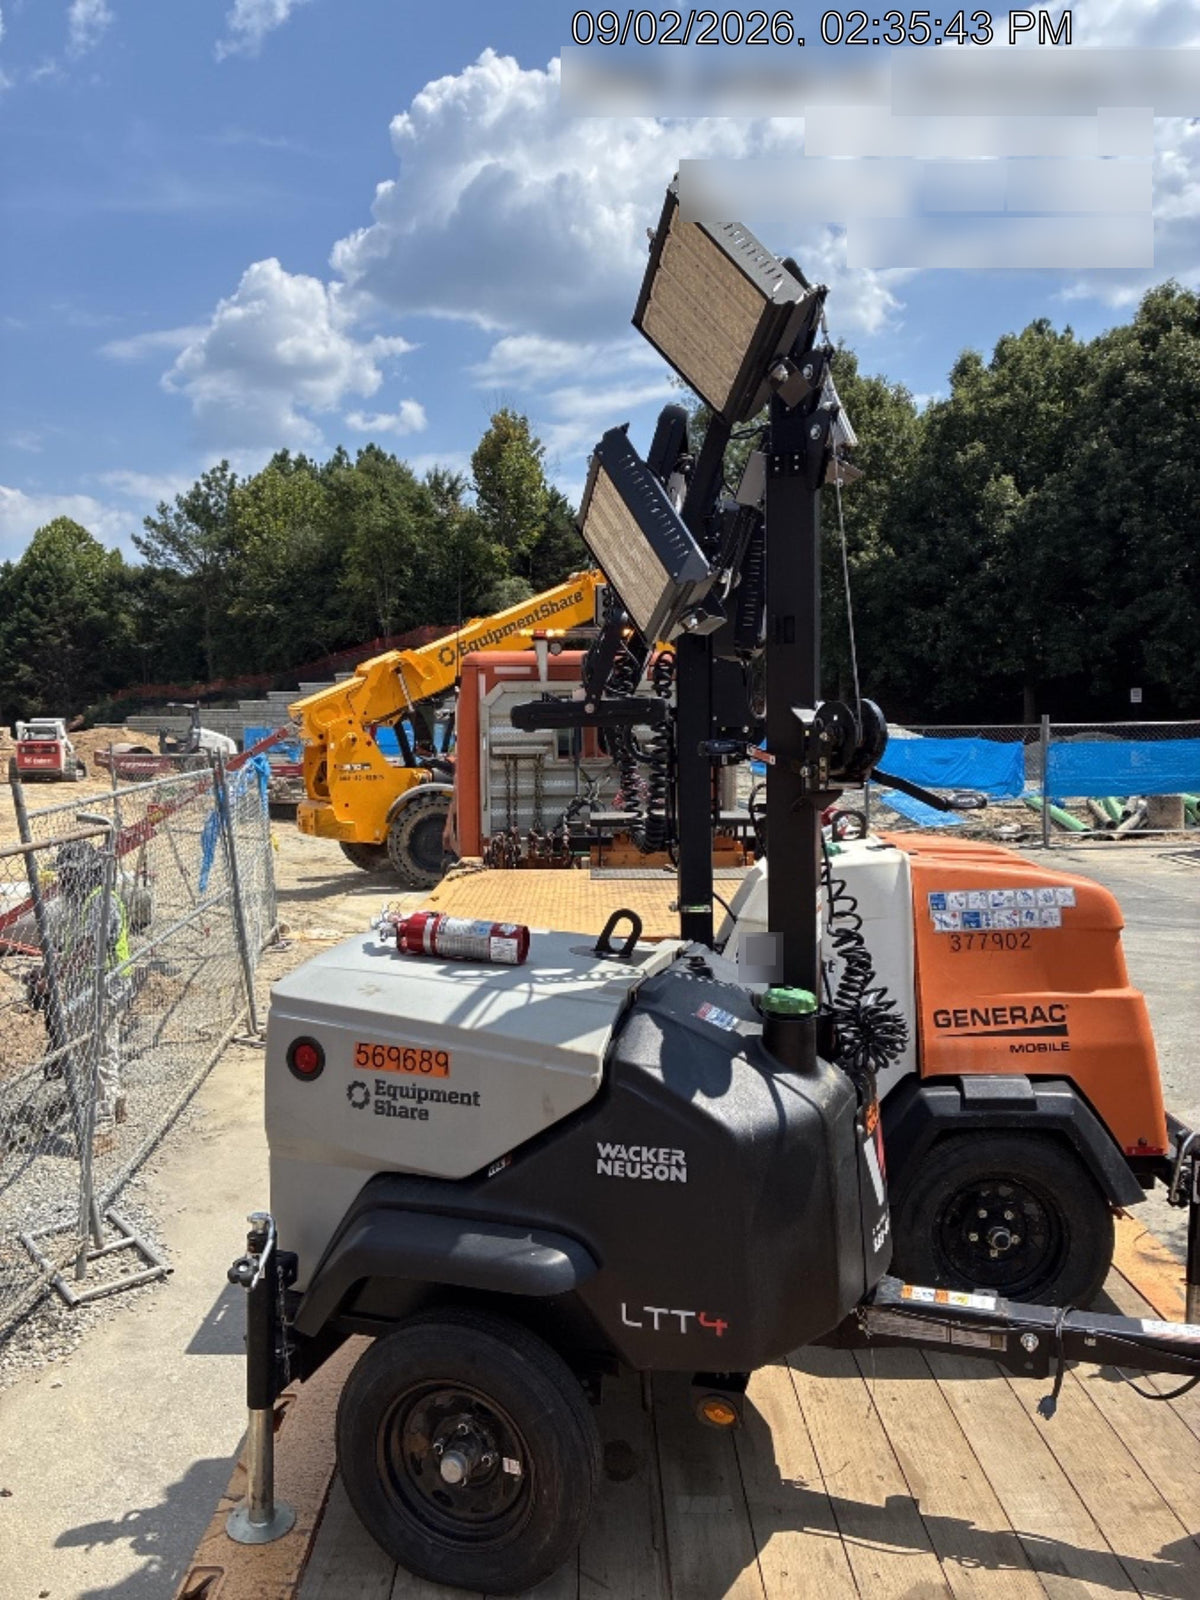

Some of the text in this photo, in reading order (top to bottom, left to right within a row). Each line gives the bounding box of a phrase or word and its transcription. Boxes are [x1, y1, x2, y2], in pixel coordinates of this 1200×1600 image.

[460, 590, 584, 657] EquipmentShare
[950, 931, 1032, 952] 377902
[933, 1003, 1067, 1029] GENERAC
[356, 1042, 449, 1075] 569689
[1009, 1041, 1071, 1054] MOBILE
[374, 1078, 481, 1107] Equipment
[374, 1100, 429, 1121] Share
[596, 1142, 687, 1165] WACKER
[596, 1158, 687, 1183] NEUSON
[621, 1302, 728, 1337] LTT4
